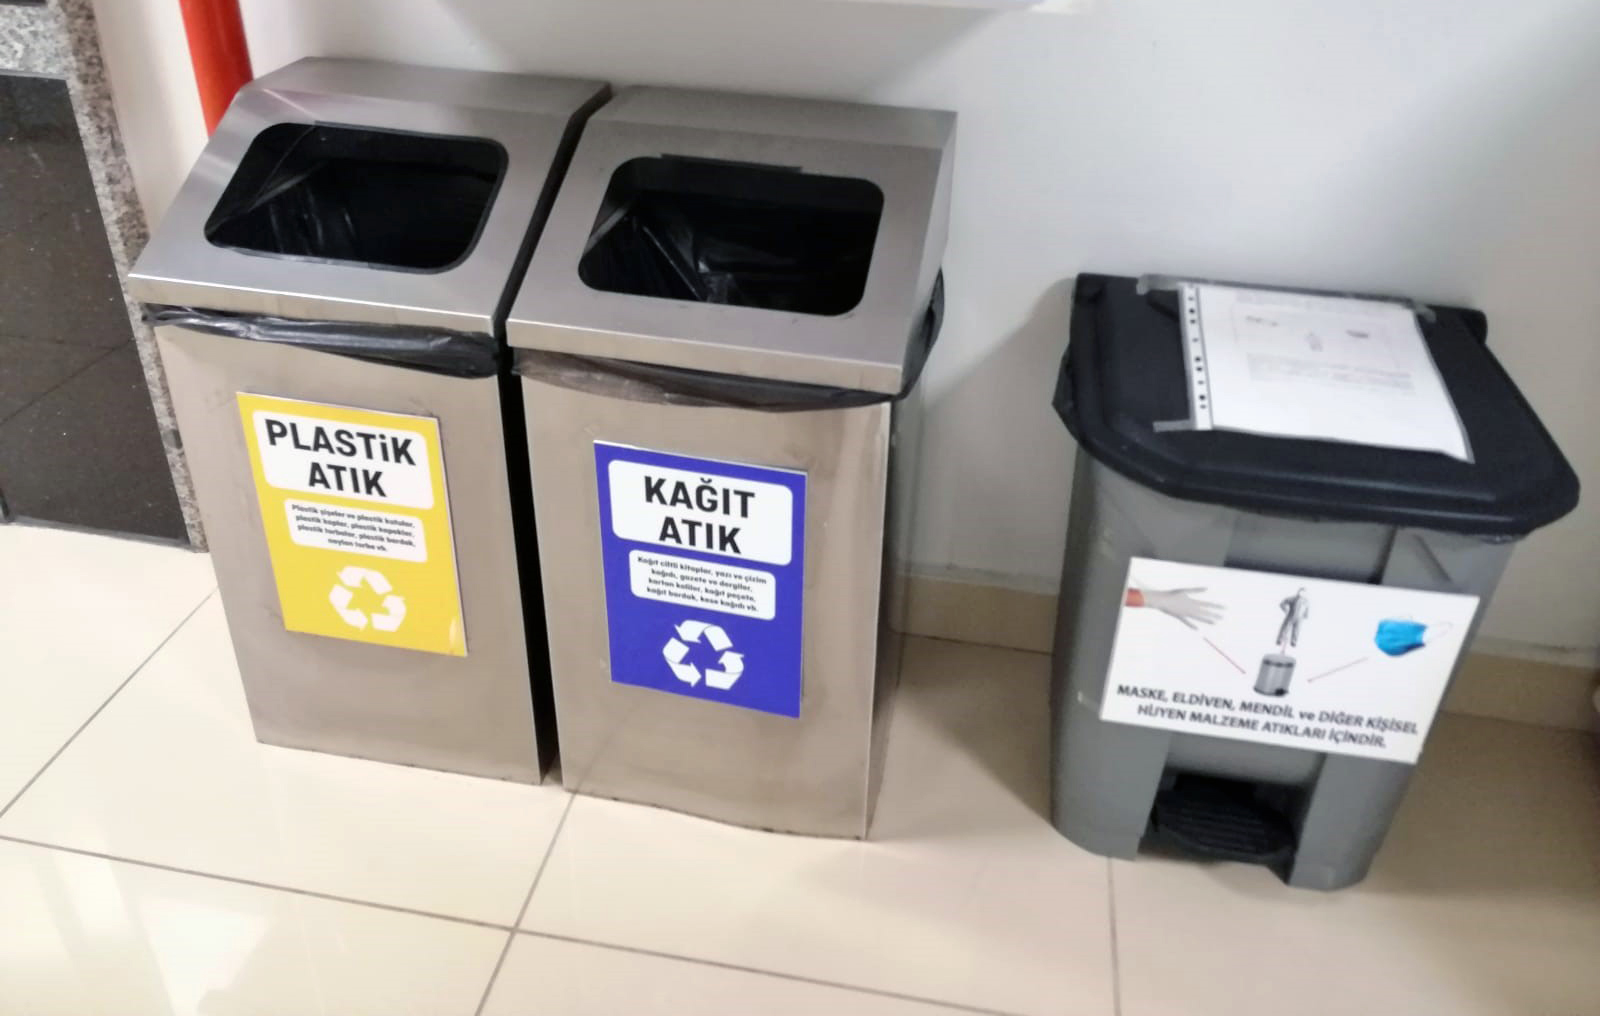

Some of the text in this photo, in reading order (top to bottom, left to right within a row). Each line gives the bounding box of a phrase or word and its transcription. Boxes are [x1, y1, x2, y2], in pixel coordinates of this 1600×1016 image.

[308, 462, 387, 497] ATIK
[644, 475, 755, 518] KAĞIT
[291, 504, 318, 514] Plastik
[357, 514, 383, 524] plastik
[296, 515, 321, 523] plastik
[350, 522, 376, 532] plastik
[297, 524, 323, 533] plastik
[359, 532, 384, 542] plastik
[328, 538, 354, 547] naylon
[376, 544, 388, 552] vb.
[659, 516, 741, 554] ATIK
[638, 556, 659, 566] Kağıt
[660, 559, 679, 569] ciltli
[680, 562, 714, 576] kitaplar,
[715, 570, 732, 579] yazı
[744, 576, 767, 584] çizim
[680, 574, 706, 584] gazete
[708, 578, 718, 586] ve
[646, 586, 667, 596] kağıt
[700, 596, 719, 604] kese
[720, 598, 746, 609] kağıdı
[746, 604, 759, 612] vb.
[648, 578, 674, 587] karton
[704, 587, 726, 597] kağıt
[1117, 684, 1418, 735] MASKE, ELDİVEN, MENDİL ve DİĞER KİŞİSEL
[1189, 711, 1259, 731] MALZEME
[1261, 720, 1327, 740] ATIKLARI
[1328, 727, 1387, 748] İÇİNDİR.
